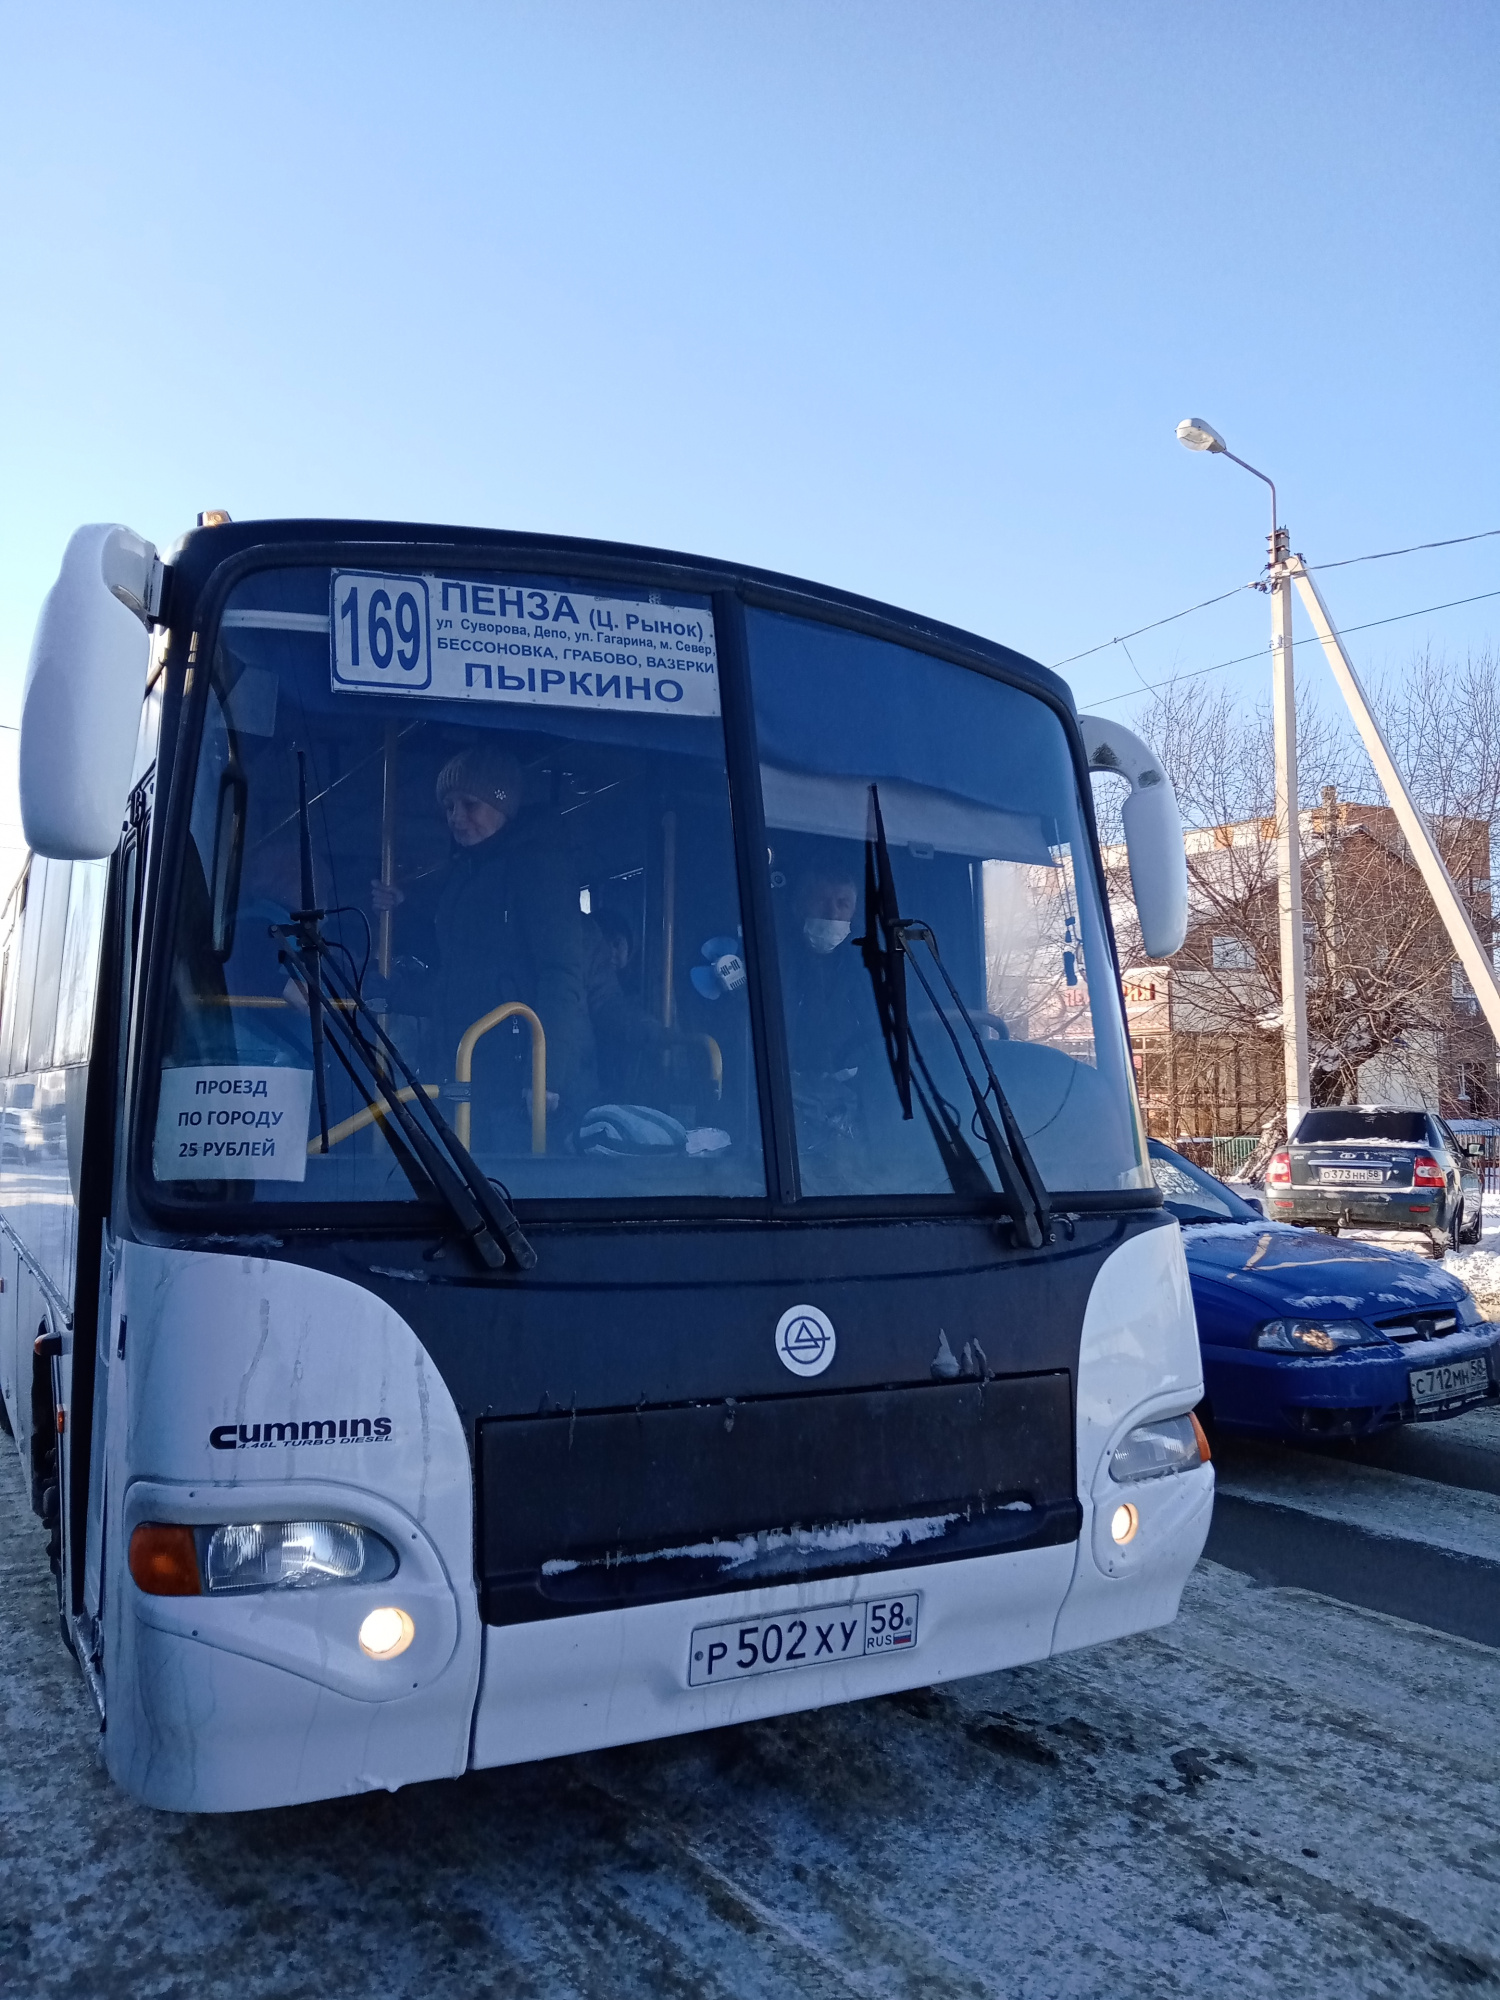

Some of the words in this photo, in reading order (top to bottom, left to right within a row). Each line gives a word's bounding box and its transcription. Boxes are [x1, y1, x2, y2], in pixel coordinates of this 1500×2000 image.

[441, 581, 580, 624] ПЕНЗА
[589, 608, 619, 632] (Ц.
[626, 613, 703, 642] РЫНОК)
[340, 587, 420, 671] 169
[460, 618, 531, 637] Суворова,
[533, 625, 571, 641] Депо,
[597, 632, 657, 650] Гагарина,
[660, 641, 673, 650] м.
[675, 640, 716, 656] Север,
[437, 637, 558, 660] БЕССОНОВКА,
[563, 649, 642, 668] ГРАБОВО,
[646, 656, 715, 674] ВАЗЕРКИ
[465, 662, 684, 703] ПЫРКИНО
[195, 1080, 268, 1097] ПРОЕЗД
[178, 1111, 202, 1126] ПО
[207, 1111, 284, 1128] ГОРОДУ
[178, 1142, 199, 1157] 25
[203, 1138, 276, 1157] РУБЛЕЙ
[1368, 1170, 1379, 1178] 58
[283, 1438, 336, 1447] TURBO
[340, 1435, 393, 1444] DIESEL
[871, 1602, 904, 1634] 58
[867, 1634, 892, 1648] RUS
